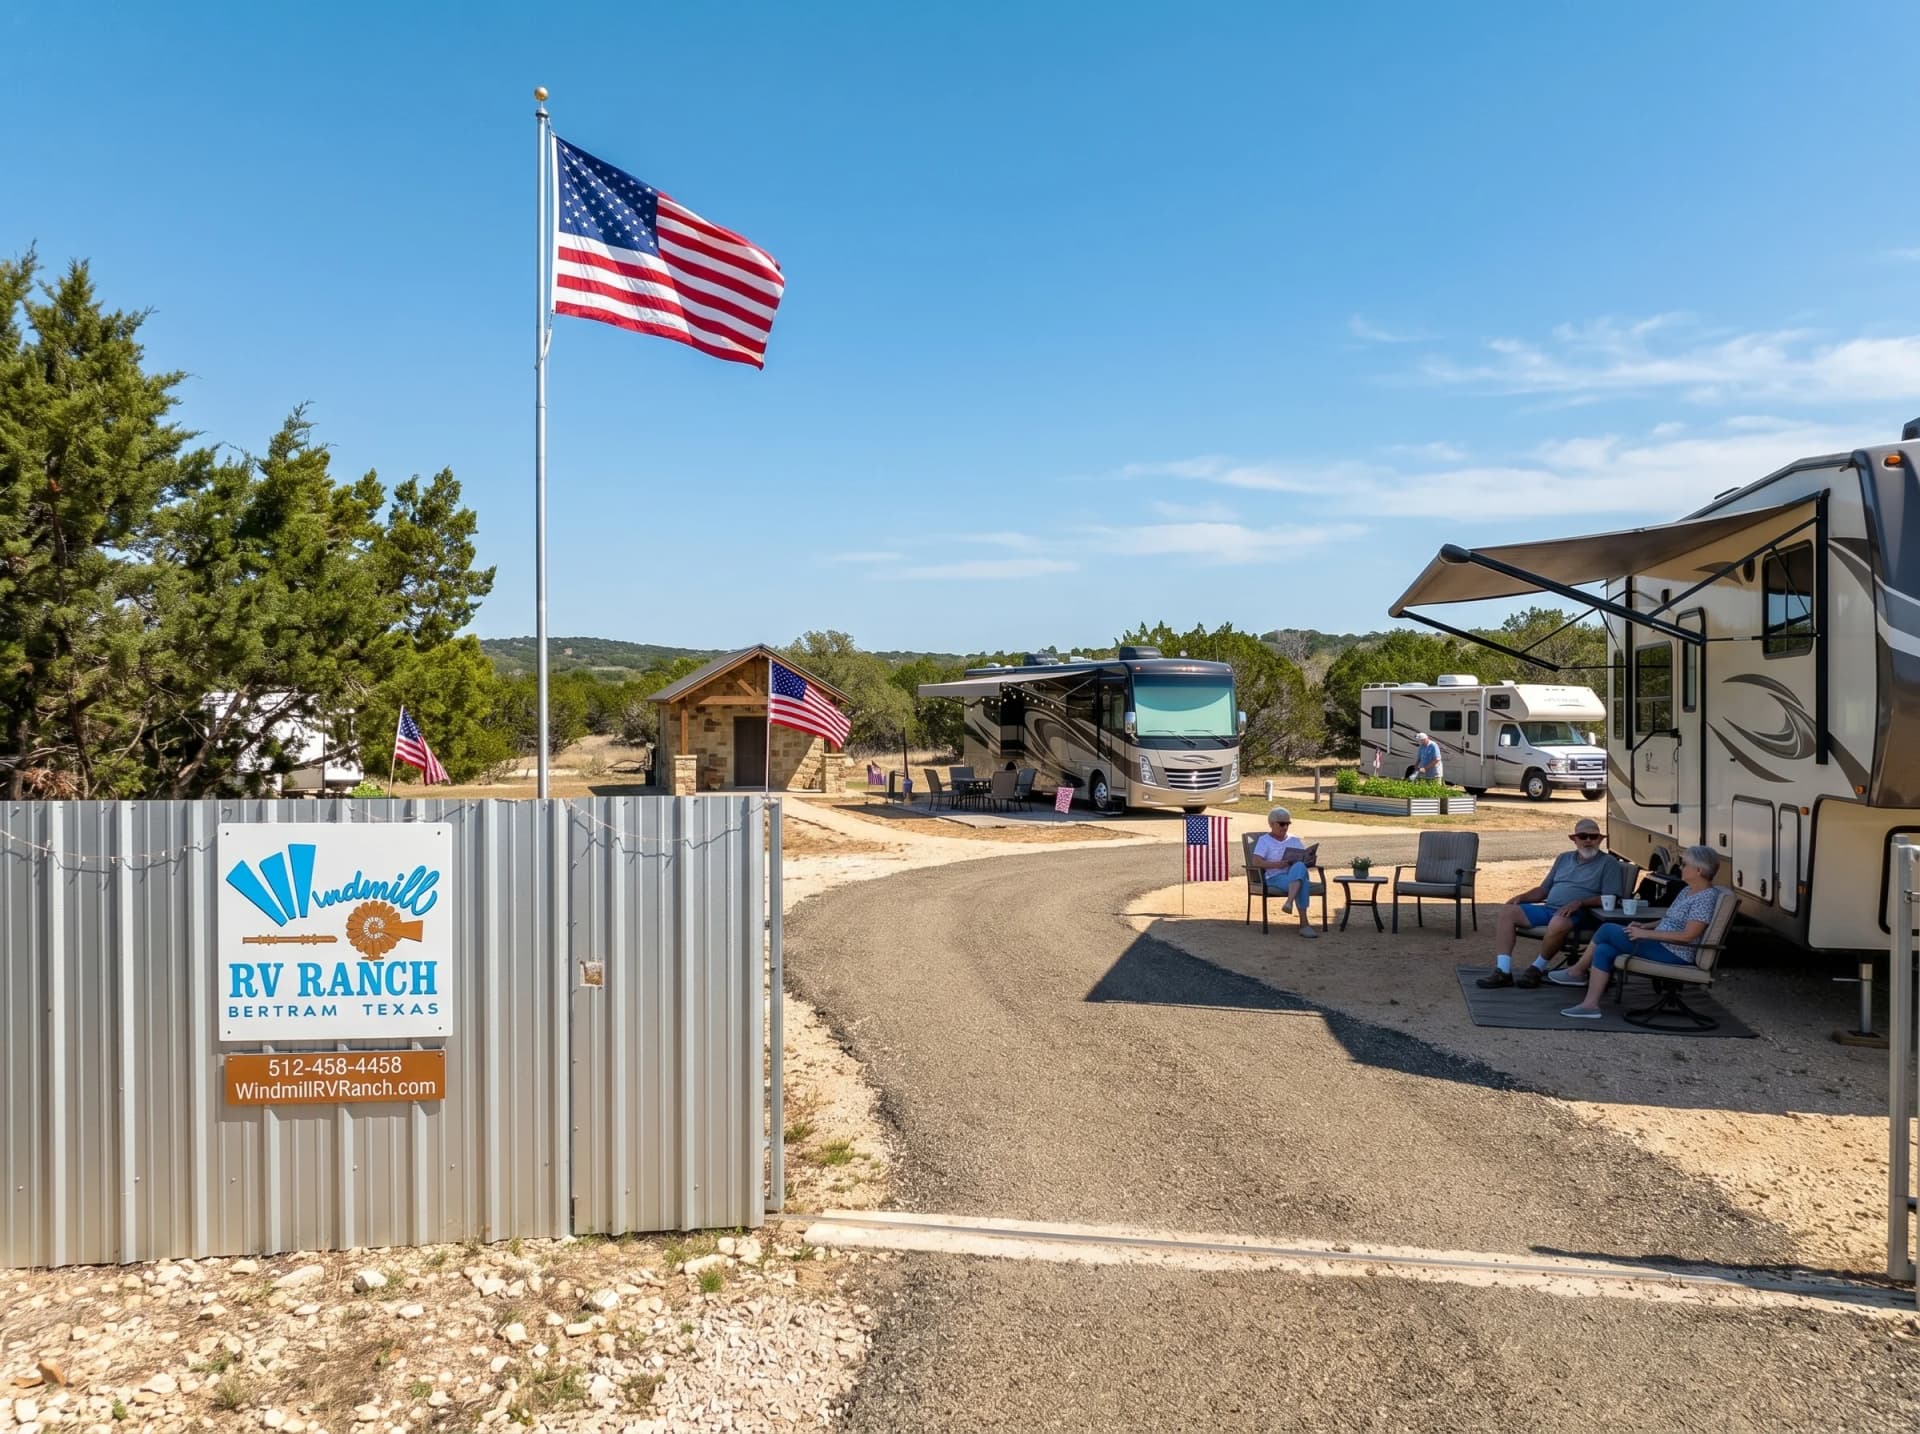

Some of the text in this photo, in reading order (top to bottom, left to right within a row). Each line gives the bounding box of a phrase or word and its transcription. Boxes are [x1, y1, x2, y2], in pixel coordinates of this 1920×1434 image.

[228, 960, 438, 998] RV RANCH
[228, 1002, 439, 1018] BERTRAM TEXAS
[268, 1056, 402, 1077] 512-458-4458
[235, 1079, 436, 1100] WindmillRVRanch.com
